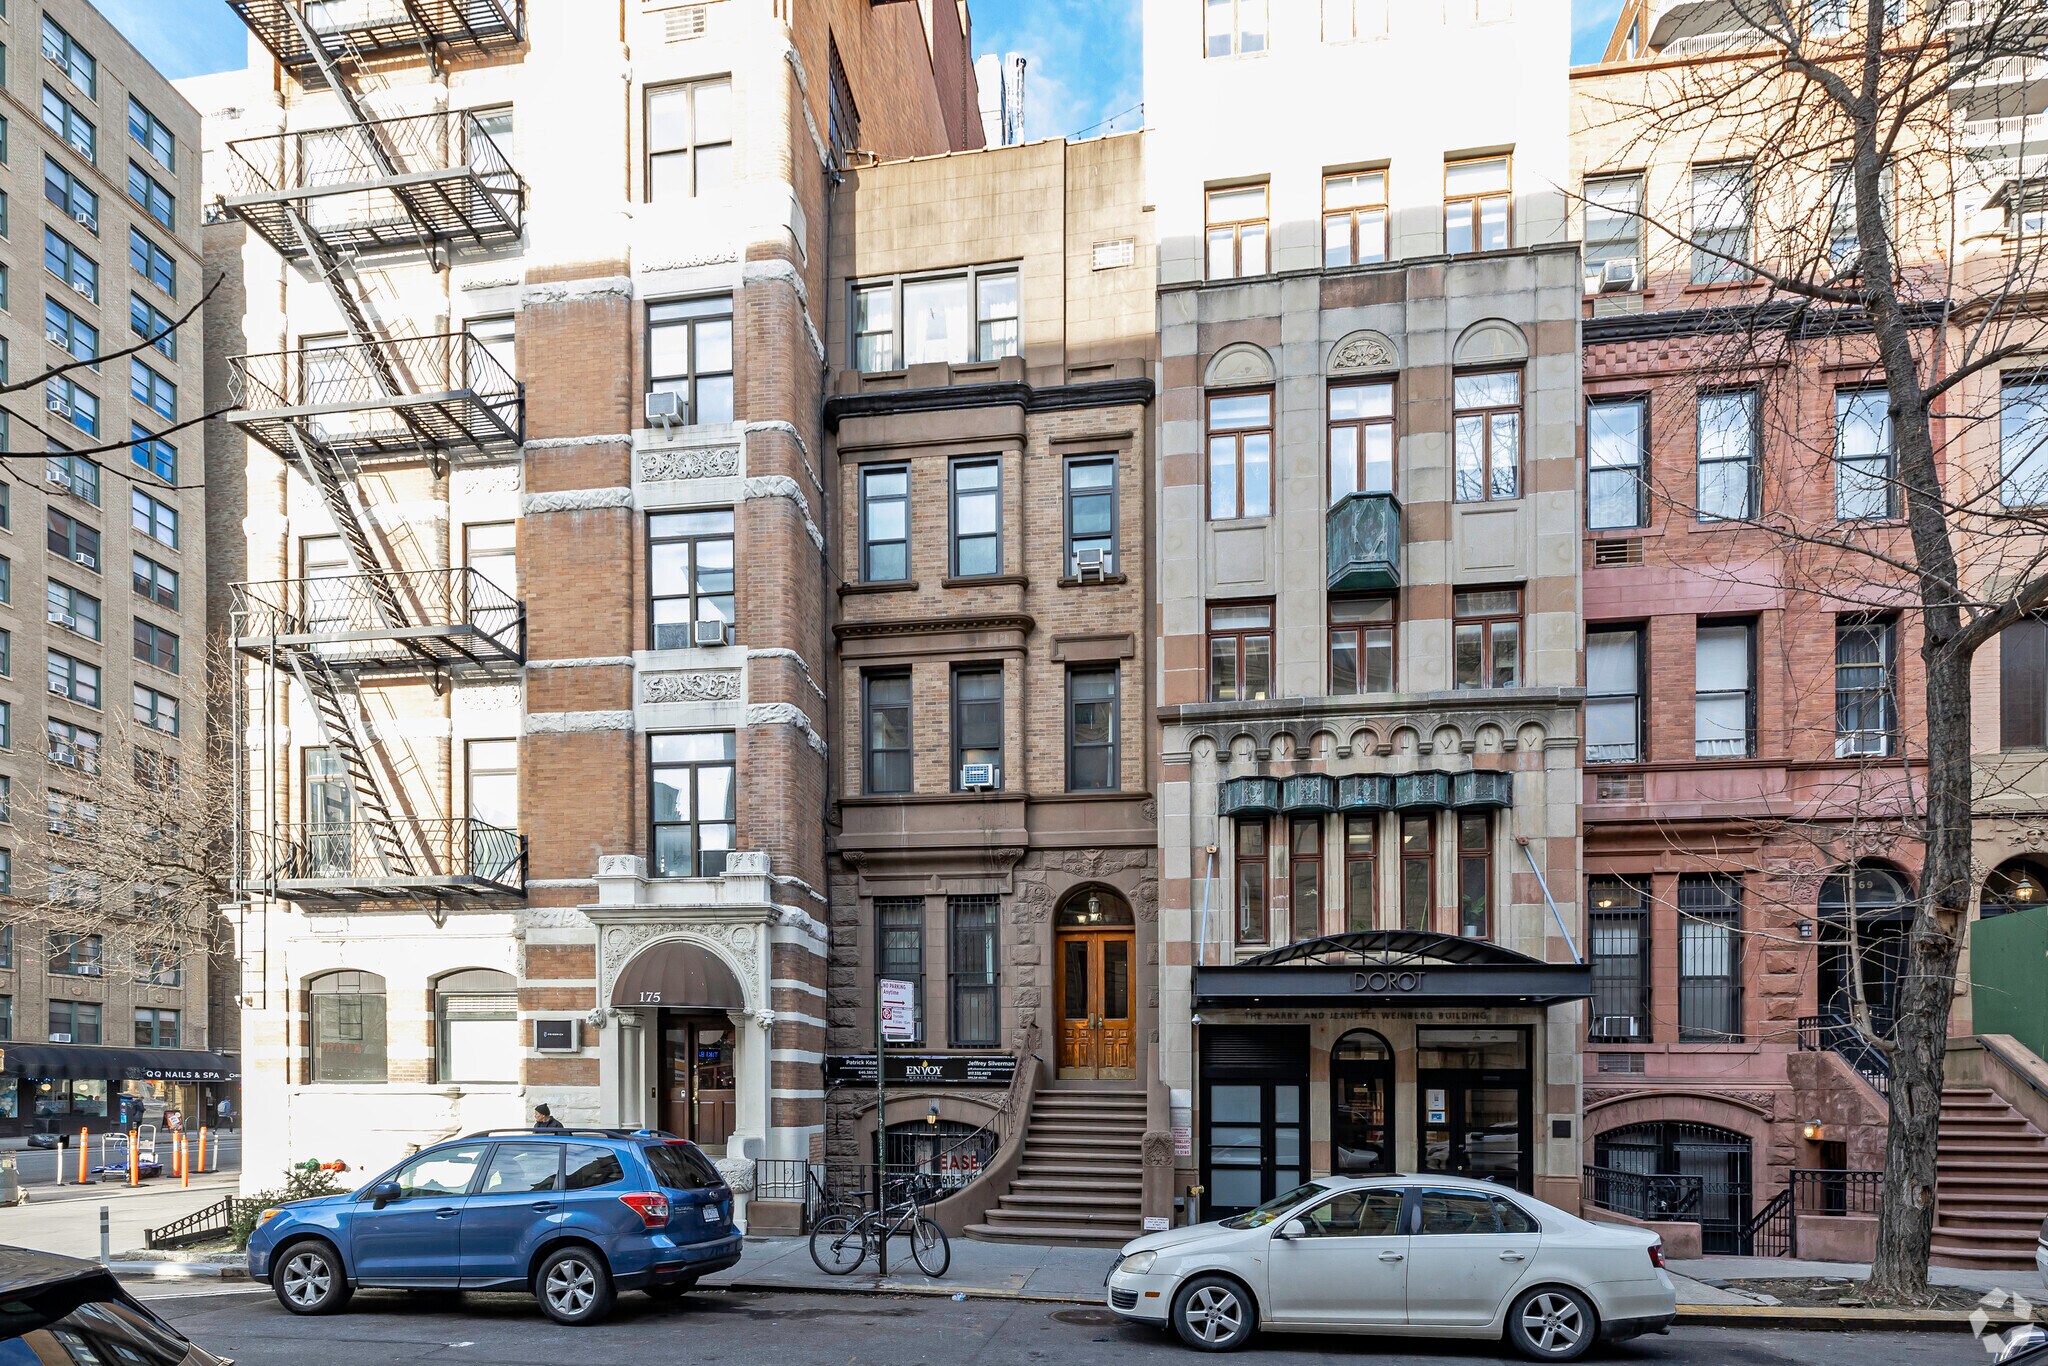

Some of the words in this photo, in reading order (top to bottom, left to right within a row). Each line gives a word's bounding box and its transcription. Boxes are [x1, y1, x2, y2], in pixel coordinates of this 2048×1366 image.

[1853, 880, 1874, 889] 69
[1354, 971, 1426, 991] DOROT
[639, 991, 662, 1003] 175
[1245, 1012, 1262, 1020] THE
[1266, 1012, 1300, 1020] HARRY
[1303, 1012, 1325, 1020] AND
[1381, 1012, 1434, 1020] WEINBERG
[1438, 1012, 1488, 1020] BUILDING
[146, 1070, 162, 1078] QQ
[165, 1071, 192, 1079] NAILS
[906, 1065, 943, 1076] ENVOY
